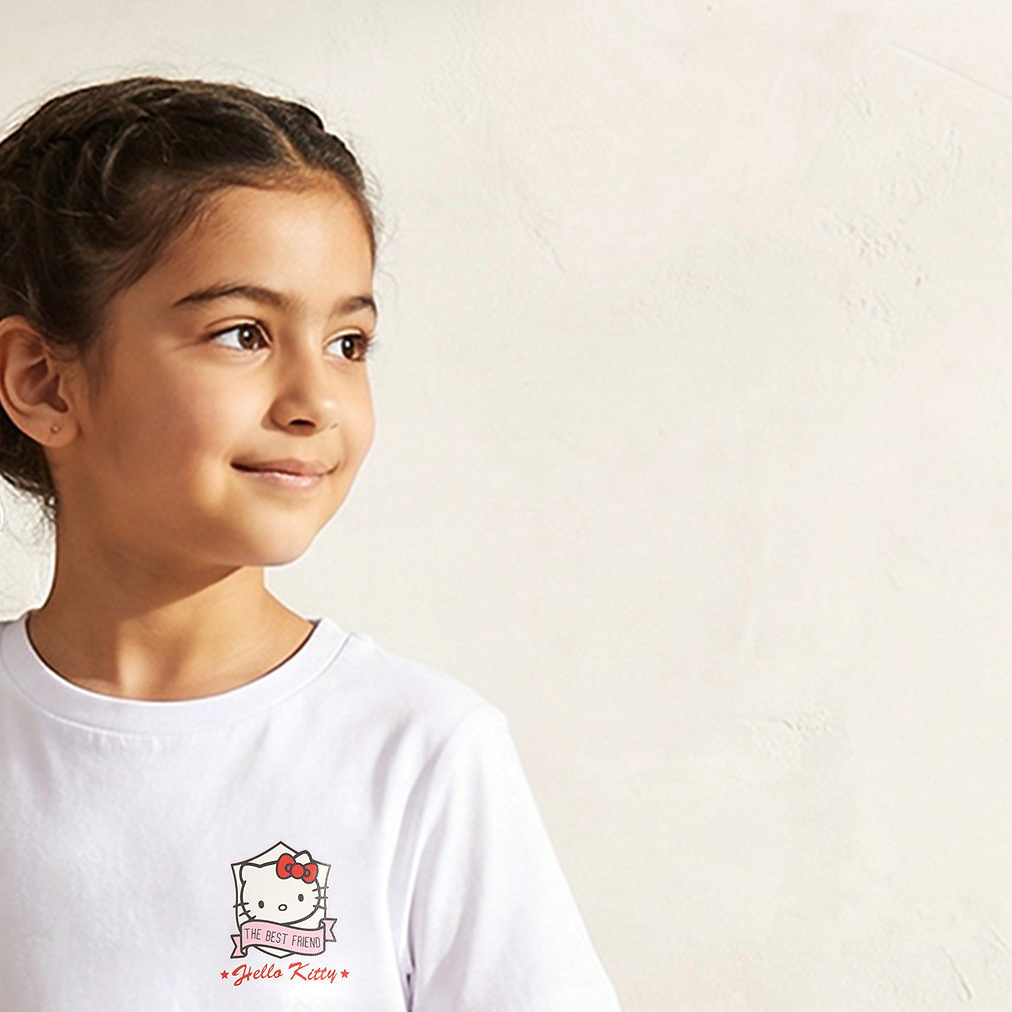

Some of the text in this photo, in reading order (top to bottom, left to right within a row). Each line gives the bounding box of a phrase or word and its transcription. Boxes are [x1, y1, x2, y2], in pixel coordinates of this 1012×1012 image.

[244, 928, 321, 949] THE BEST FRIEND
[232, 961, 338, 987] Hello Kitty
